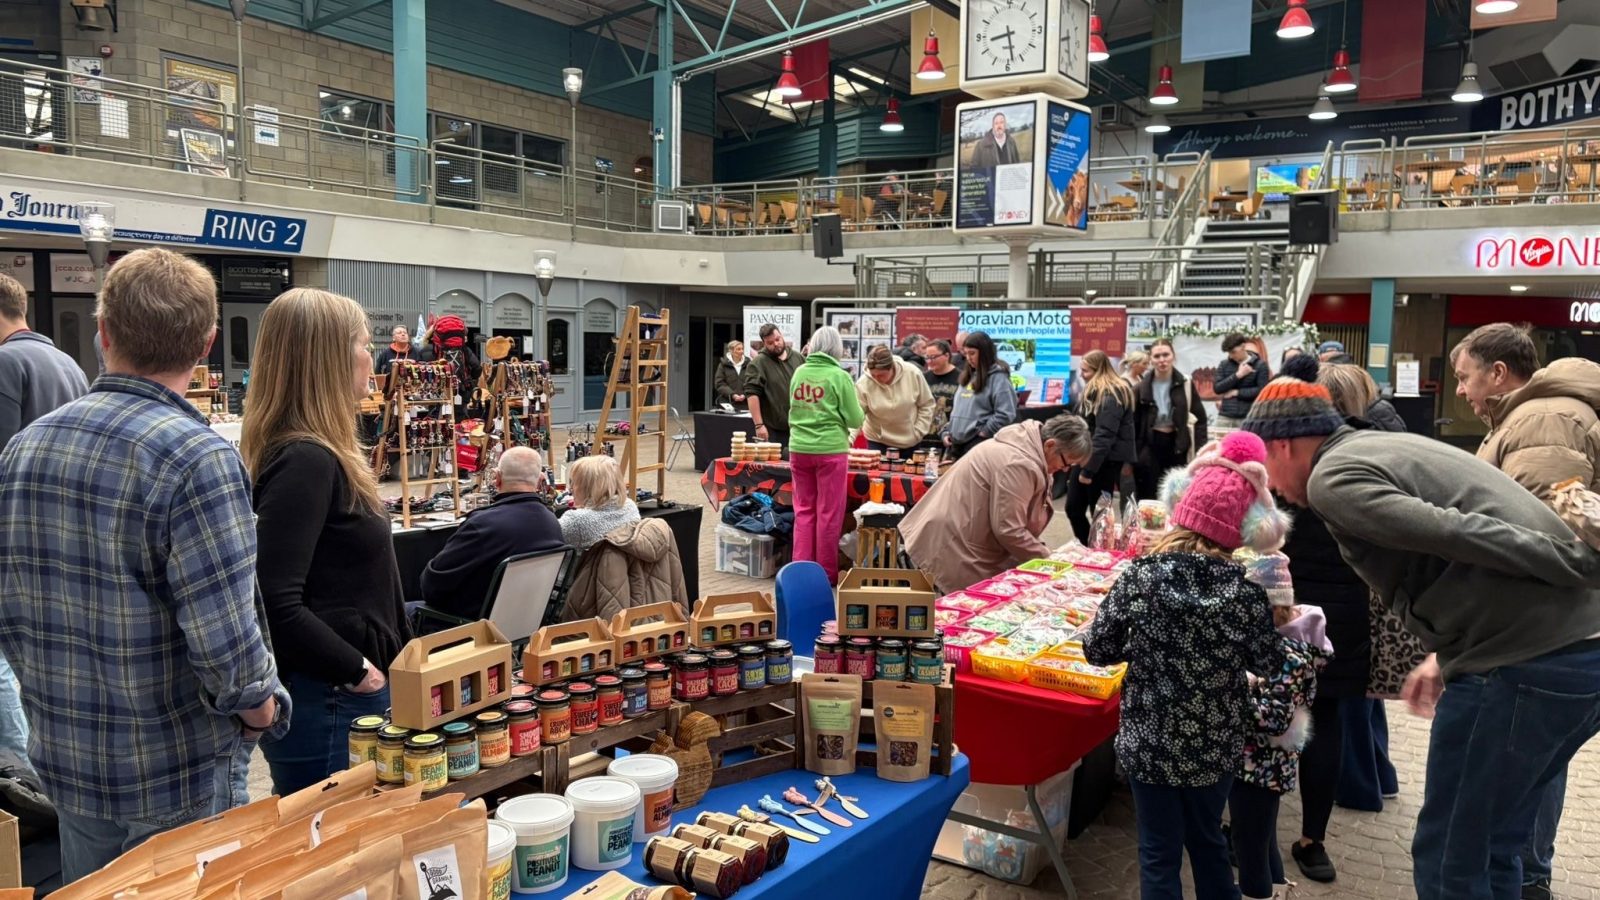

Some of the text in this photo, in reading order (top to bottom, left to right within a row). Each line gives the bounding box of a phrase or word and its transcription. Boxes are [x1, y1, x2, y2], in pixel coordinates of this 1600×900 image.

[1500, 76, 1600, 131] BOTHY
[1172, 129, 1232, 153] Always
[7, 191, 98, 220] Journ
[210, 214, 301, 246] RING 2
[1522, 240, 1552, 264] Virgin
[368, 312, 404, 321] elcome To
[750, 313, 794, 324] PANACHE
[1028, 312, 1071, 325] Moto
[448, 757, 476, 770] PEANUT
[527, 860, 560, 877] PEANUT
